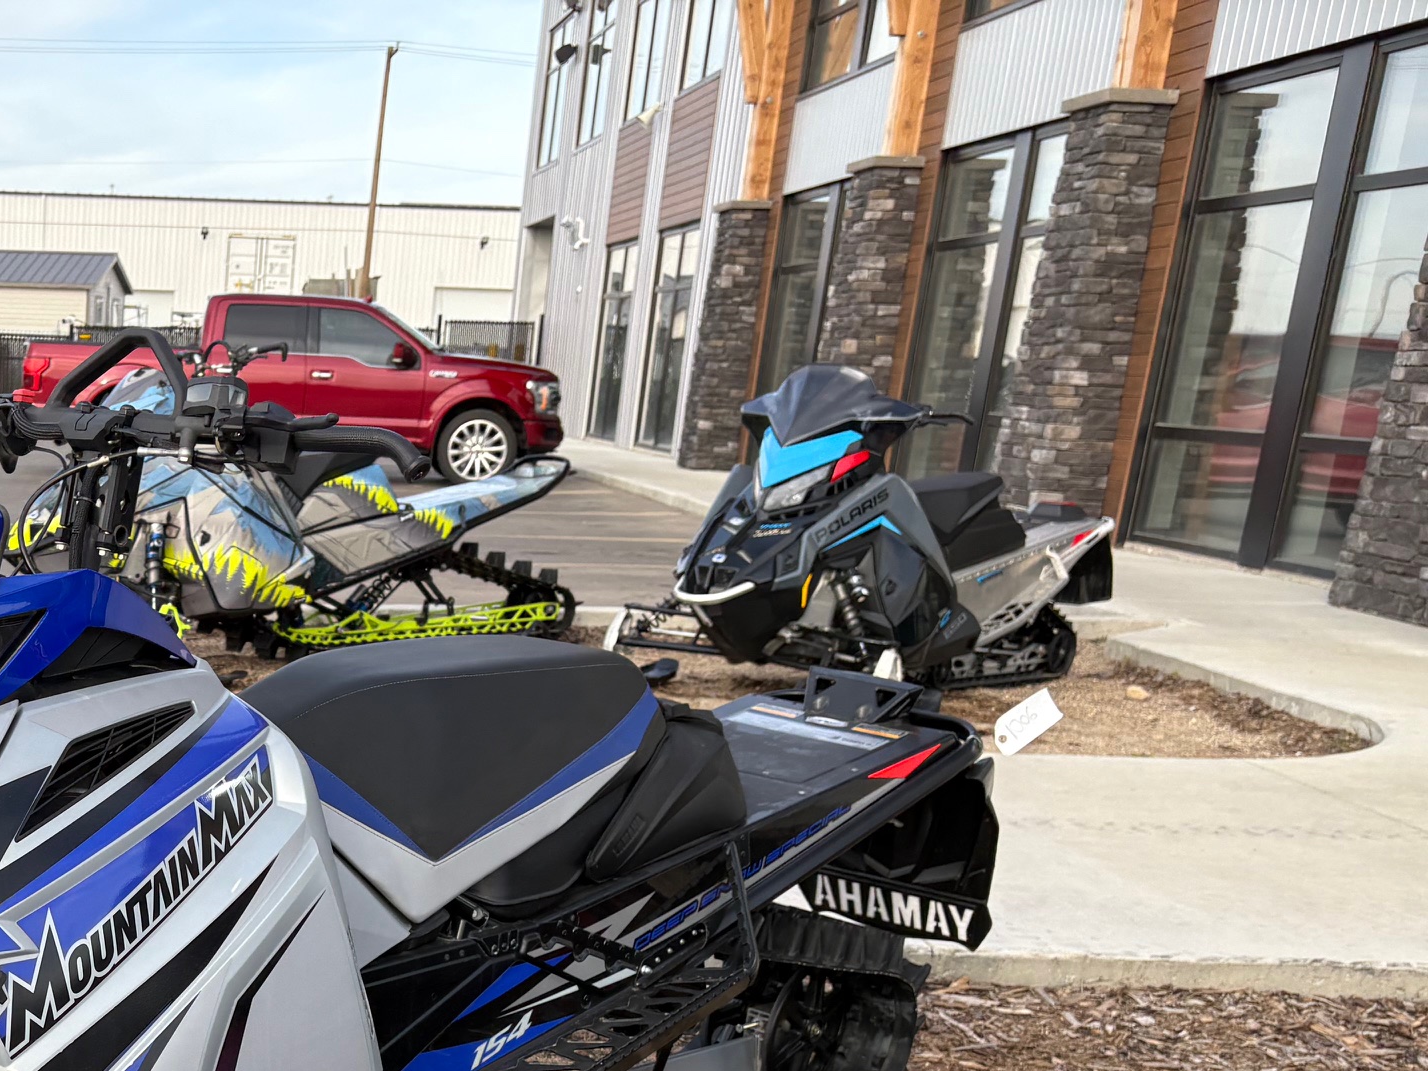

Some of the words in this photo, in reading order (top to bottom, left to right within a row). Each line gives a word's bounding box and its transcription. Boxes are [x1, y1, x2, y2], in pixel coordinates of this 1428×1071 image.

[813, 487, 889, 544] POLARIS
[632, 899, 699, 951] DEEP
[764, 804, 852, 868] SPECIAL
[470, 1009, 534, 1071] 154
